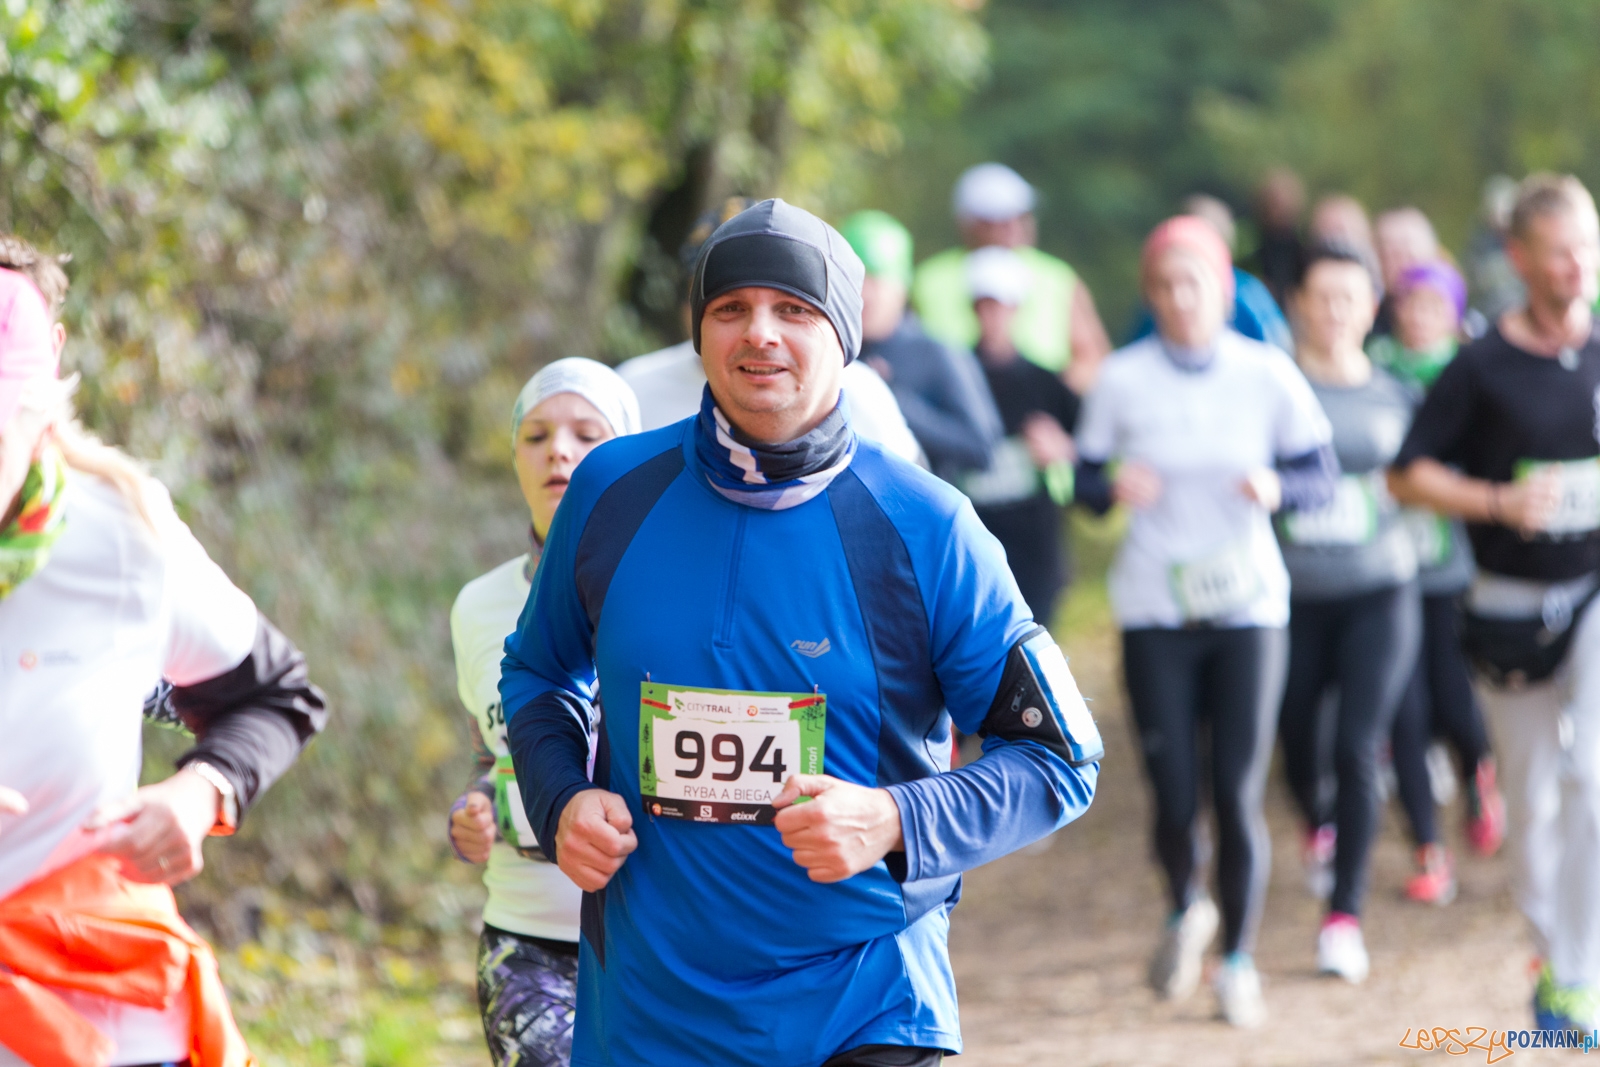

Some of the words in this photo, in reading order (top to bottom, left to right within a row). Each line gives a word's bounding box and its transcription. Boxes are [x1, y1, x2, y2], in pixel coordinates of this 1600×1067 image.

[674, 730, 787, 783] 994
[807, 746, 818, 775] znań
[684, 786, 717, 800] RYBA
[721, 787, 730, 800] A
[734, 788, 772, 801] BIEGA
